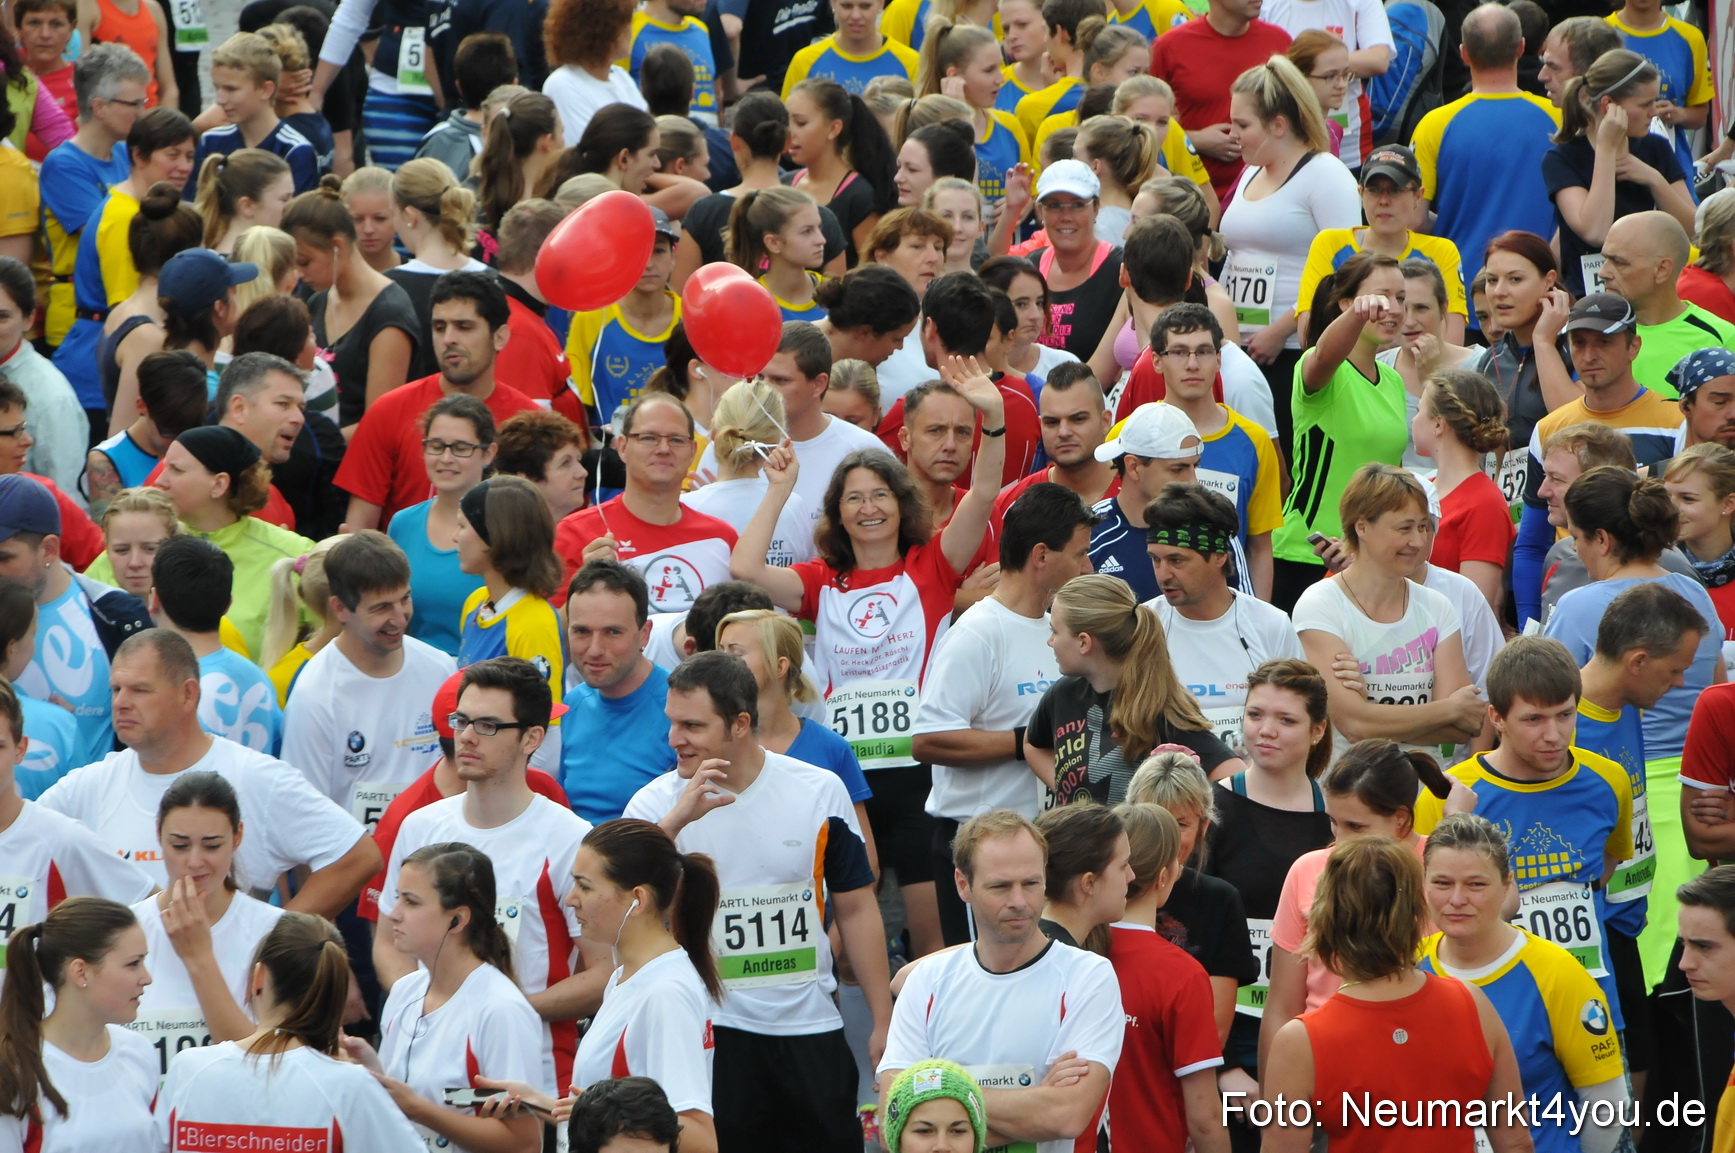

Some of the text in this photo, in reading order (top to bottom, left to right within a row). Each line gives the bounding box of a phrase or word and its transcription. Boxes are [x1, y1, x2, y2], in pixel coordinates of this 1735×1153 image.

[1098, 565, 1124, 574] adidas
[1385, 681, 1426, 692] Neumarkt
[826, 688, 901, 706] PARTL Neumarkt
[832, 701, 911, 738] 5188
[1057, 765, 1087, 807] 2007
[356, 791, 392, 802] PARTL
[752, 893, 799, 907] Neumarkt
[1531, 889, 1580, 905] Neumarkt
[725, 907, 809, 951] 5114
[742, 957, 797, 974] Andreas
